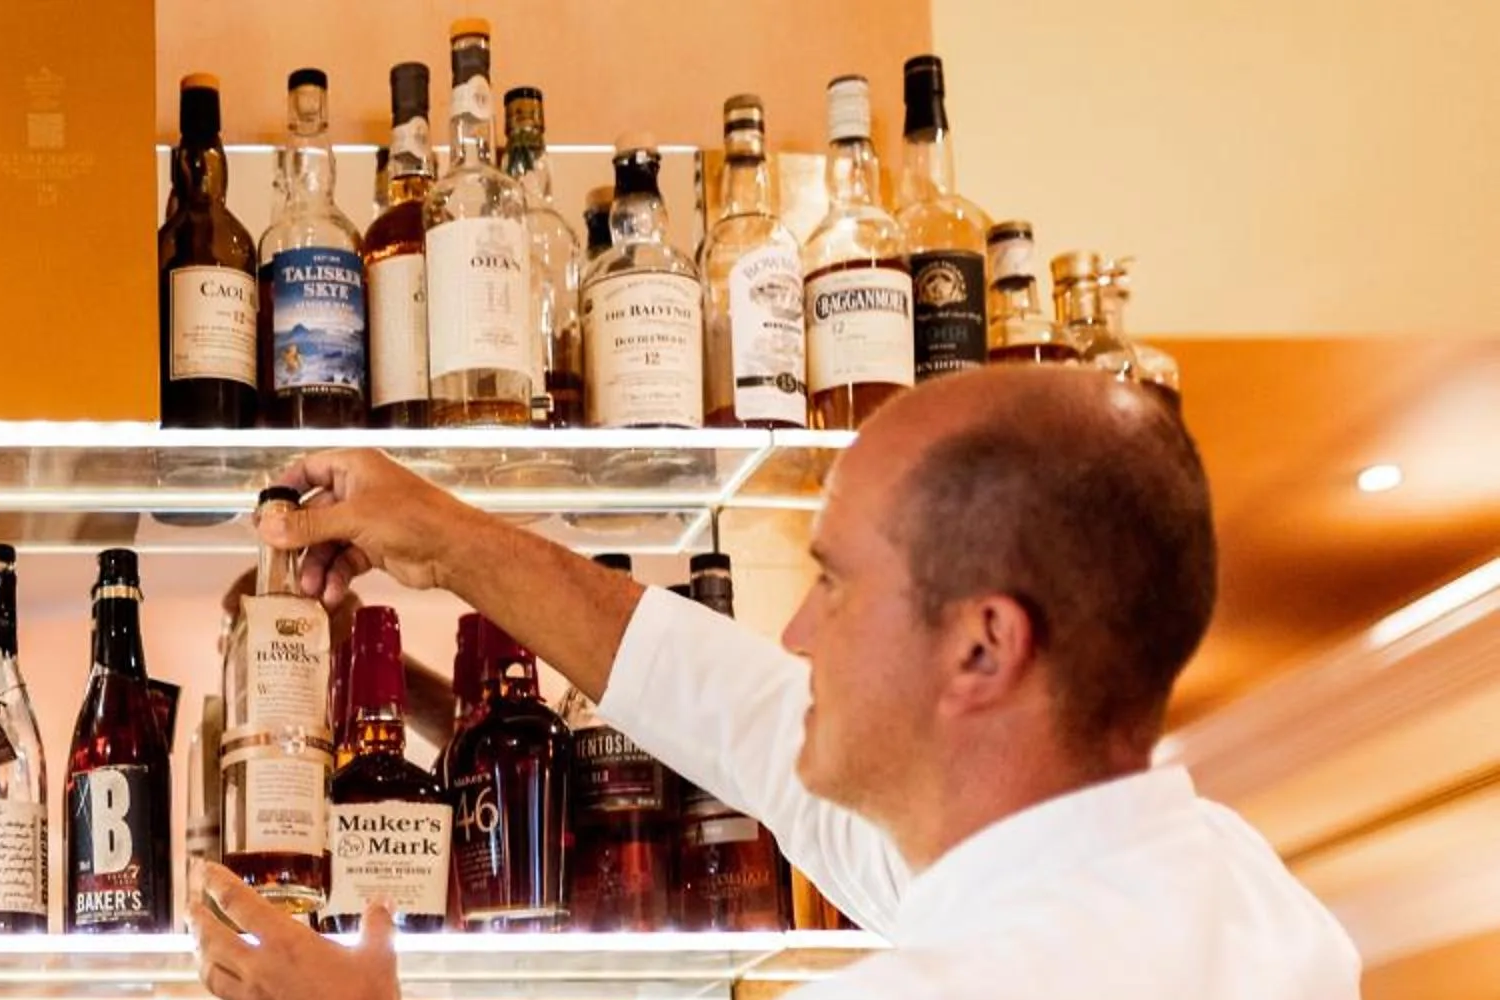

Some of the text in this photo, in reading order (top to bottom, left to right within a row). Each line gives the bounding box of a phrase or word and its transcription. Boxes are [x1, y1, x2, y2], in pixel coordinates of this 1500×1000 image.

[470, 256, 521, 272] OBAN
[303, 282, 350, 301] SKYE
[270, 640, 306, 652] BASIL
[256, 650, 321, 665] HAYDEN'S
[88, 768, 133, 876] B
[338, 815, 441, 833] Maker's
[456, 787, 499, 842] 46
[368, 837, 440, 857] Mark
[76, 889, 143, 914] BAKER'S
